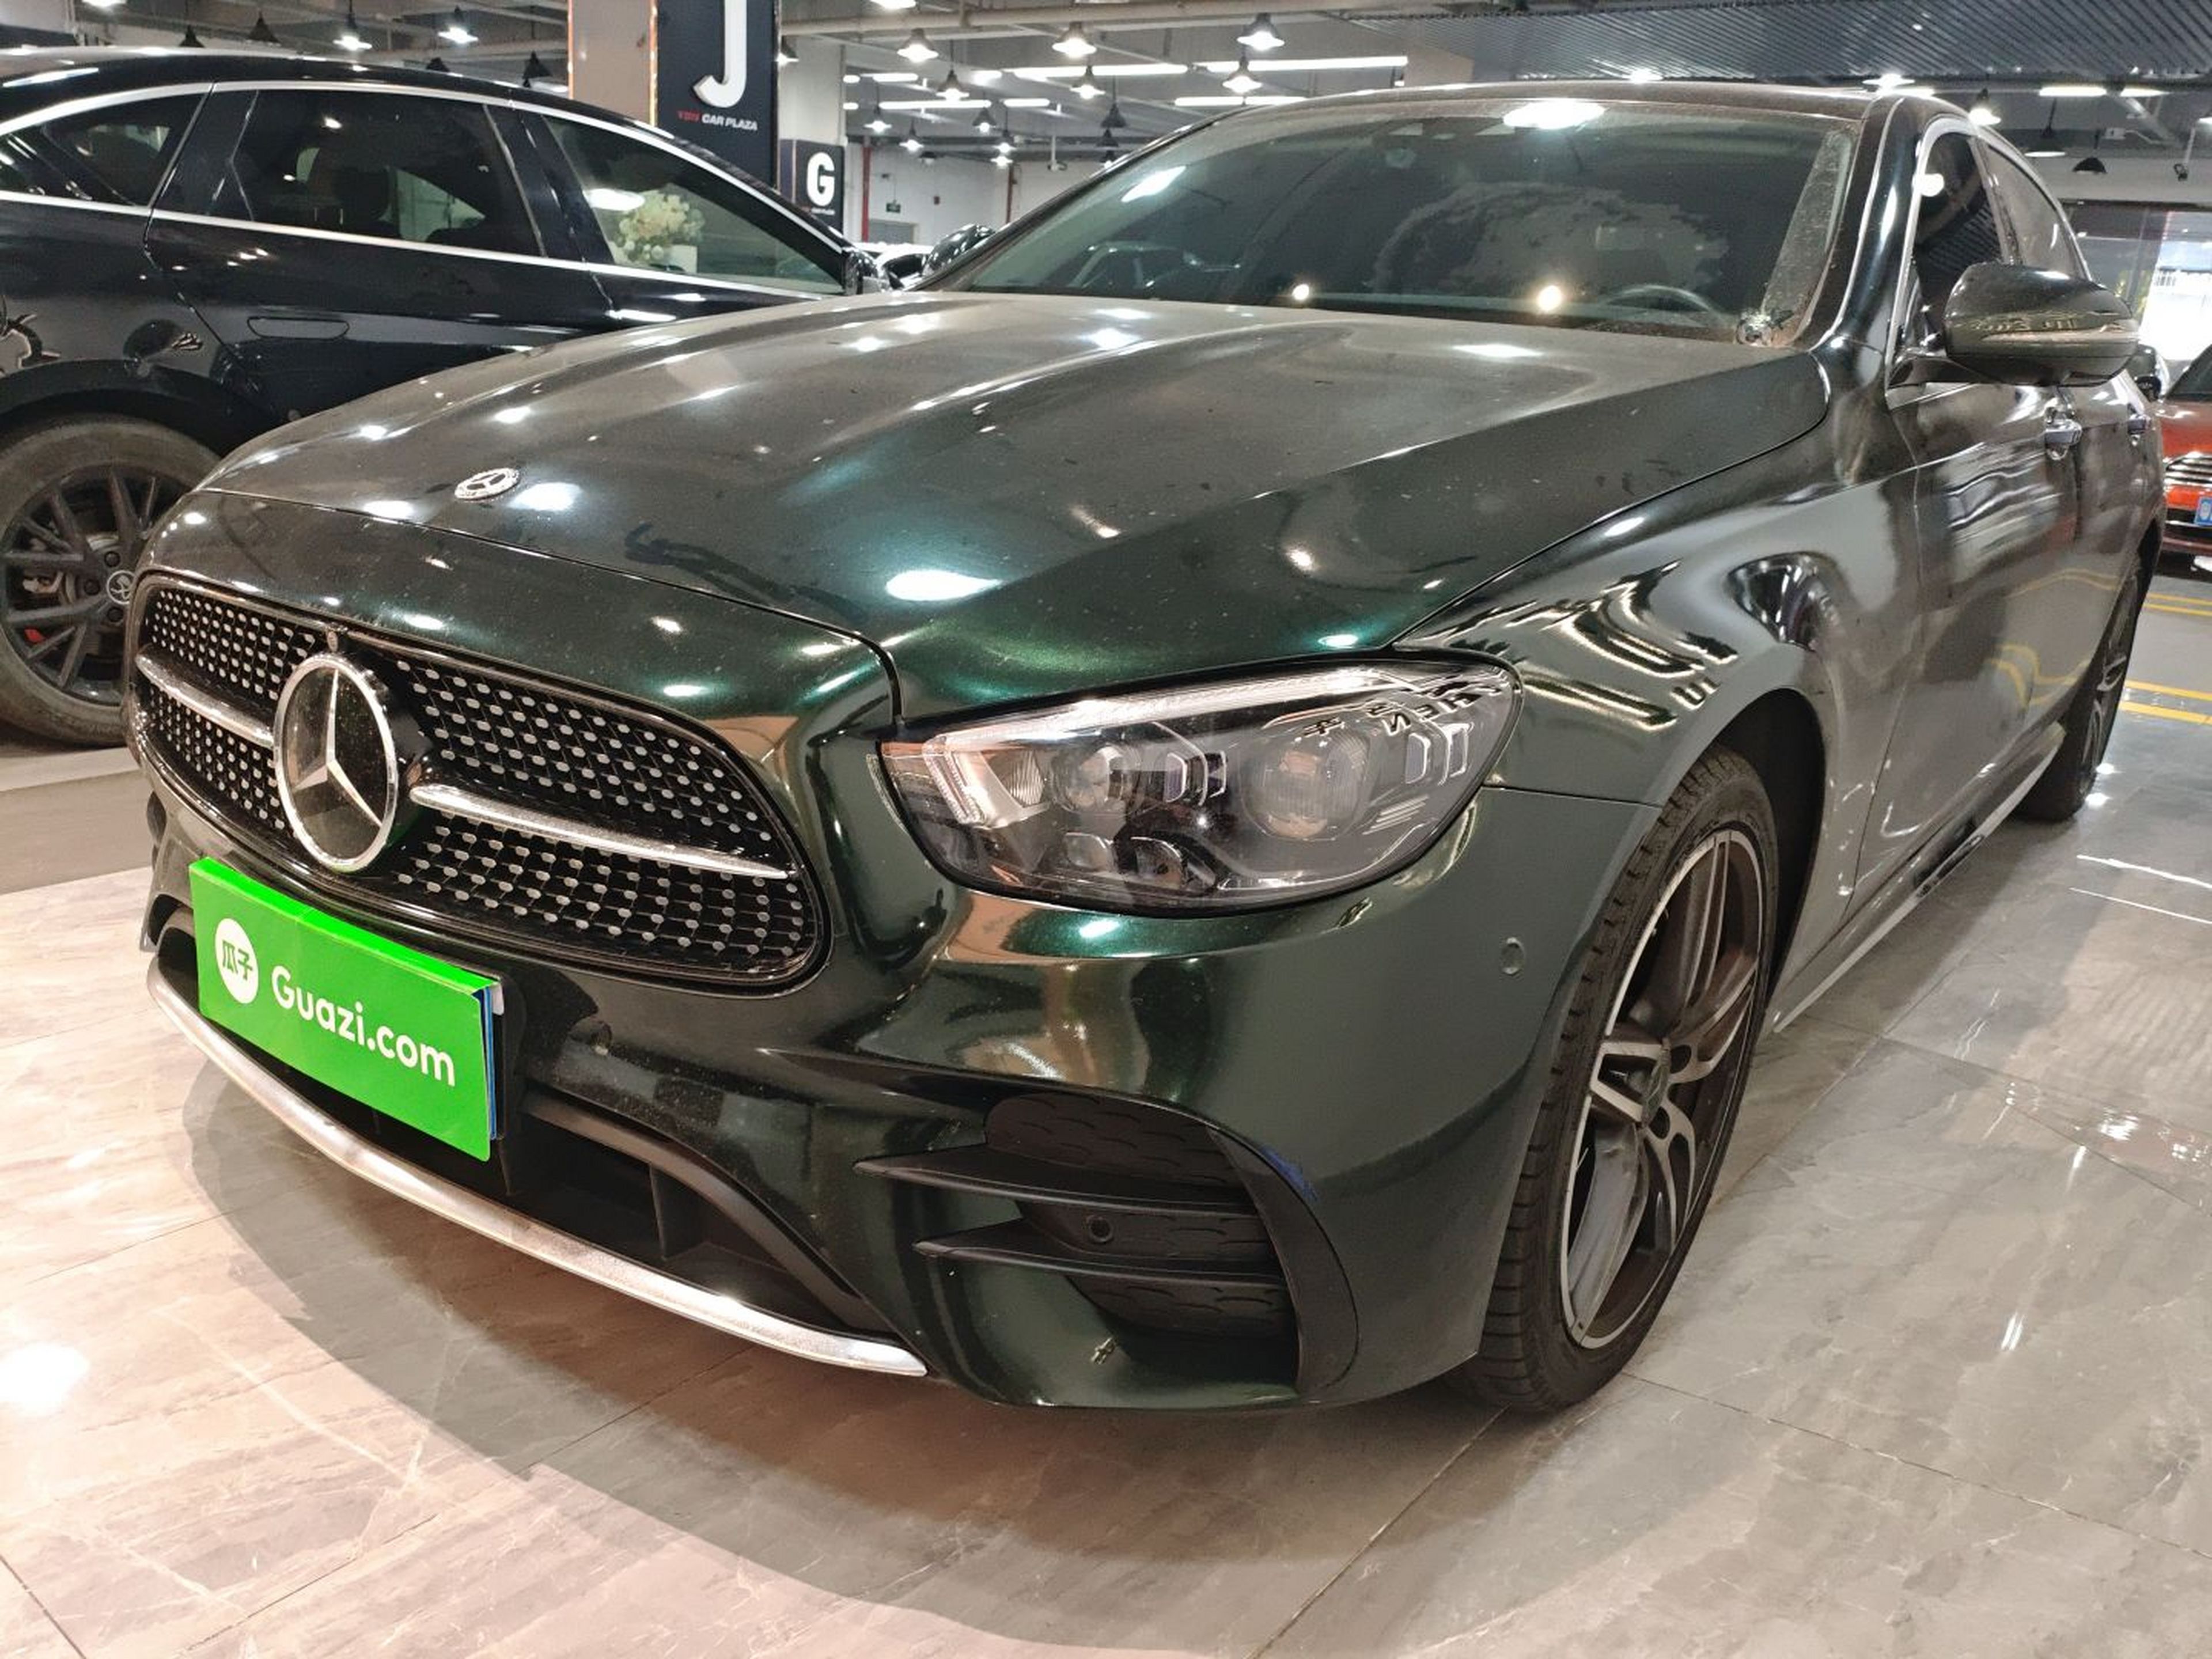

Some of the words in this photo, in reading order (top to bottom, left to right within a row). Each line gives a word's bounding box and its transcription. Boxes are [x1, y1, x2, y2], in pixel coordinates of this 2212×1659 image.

[692, 0, 747, 108] J
[701, 113, 725, 126] CAR
[725, 117, 758, 131] PLAZA
[806, 152, 835, 206] G
[222, 940, 253, 980] 瓜子
[271, 965, 455, 1086] Guazi.com
